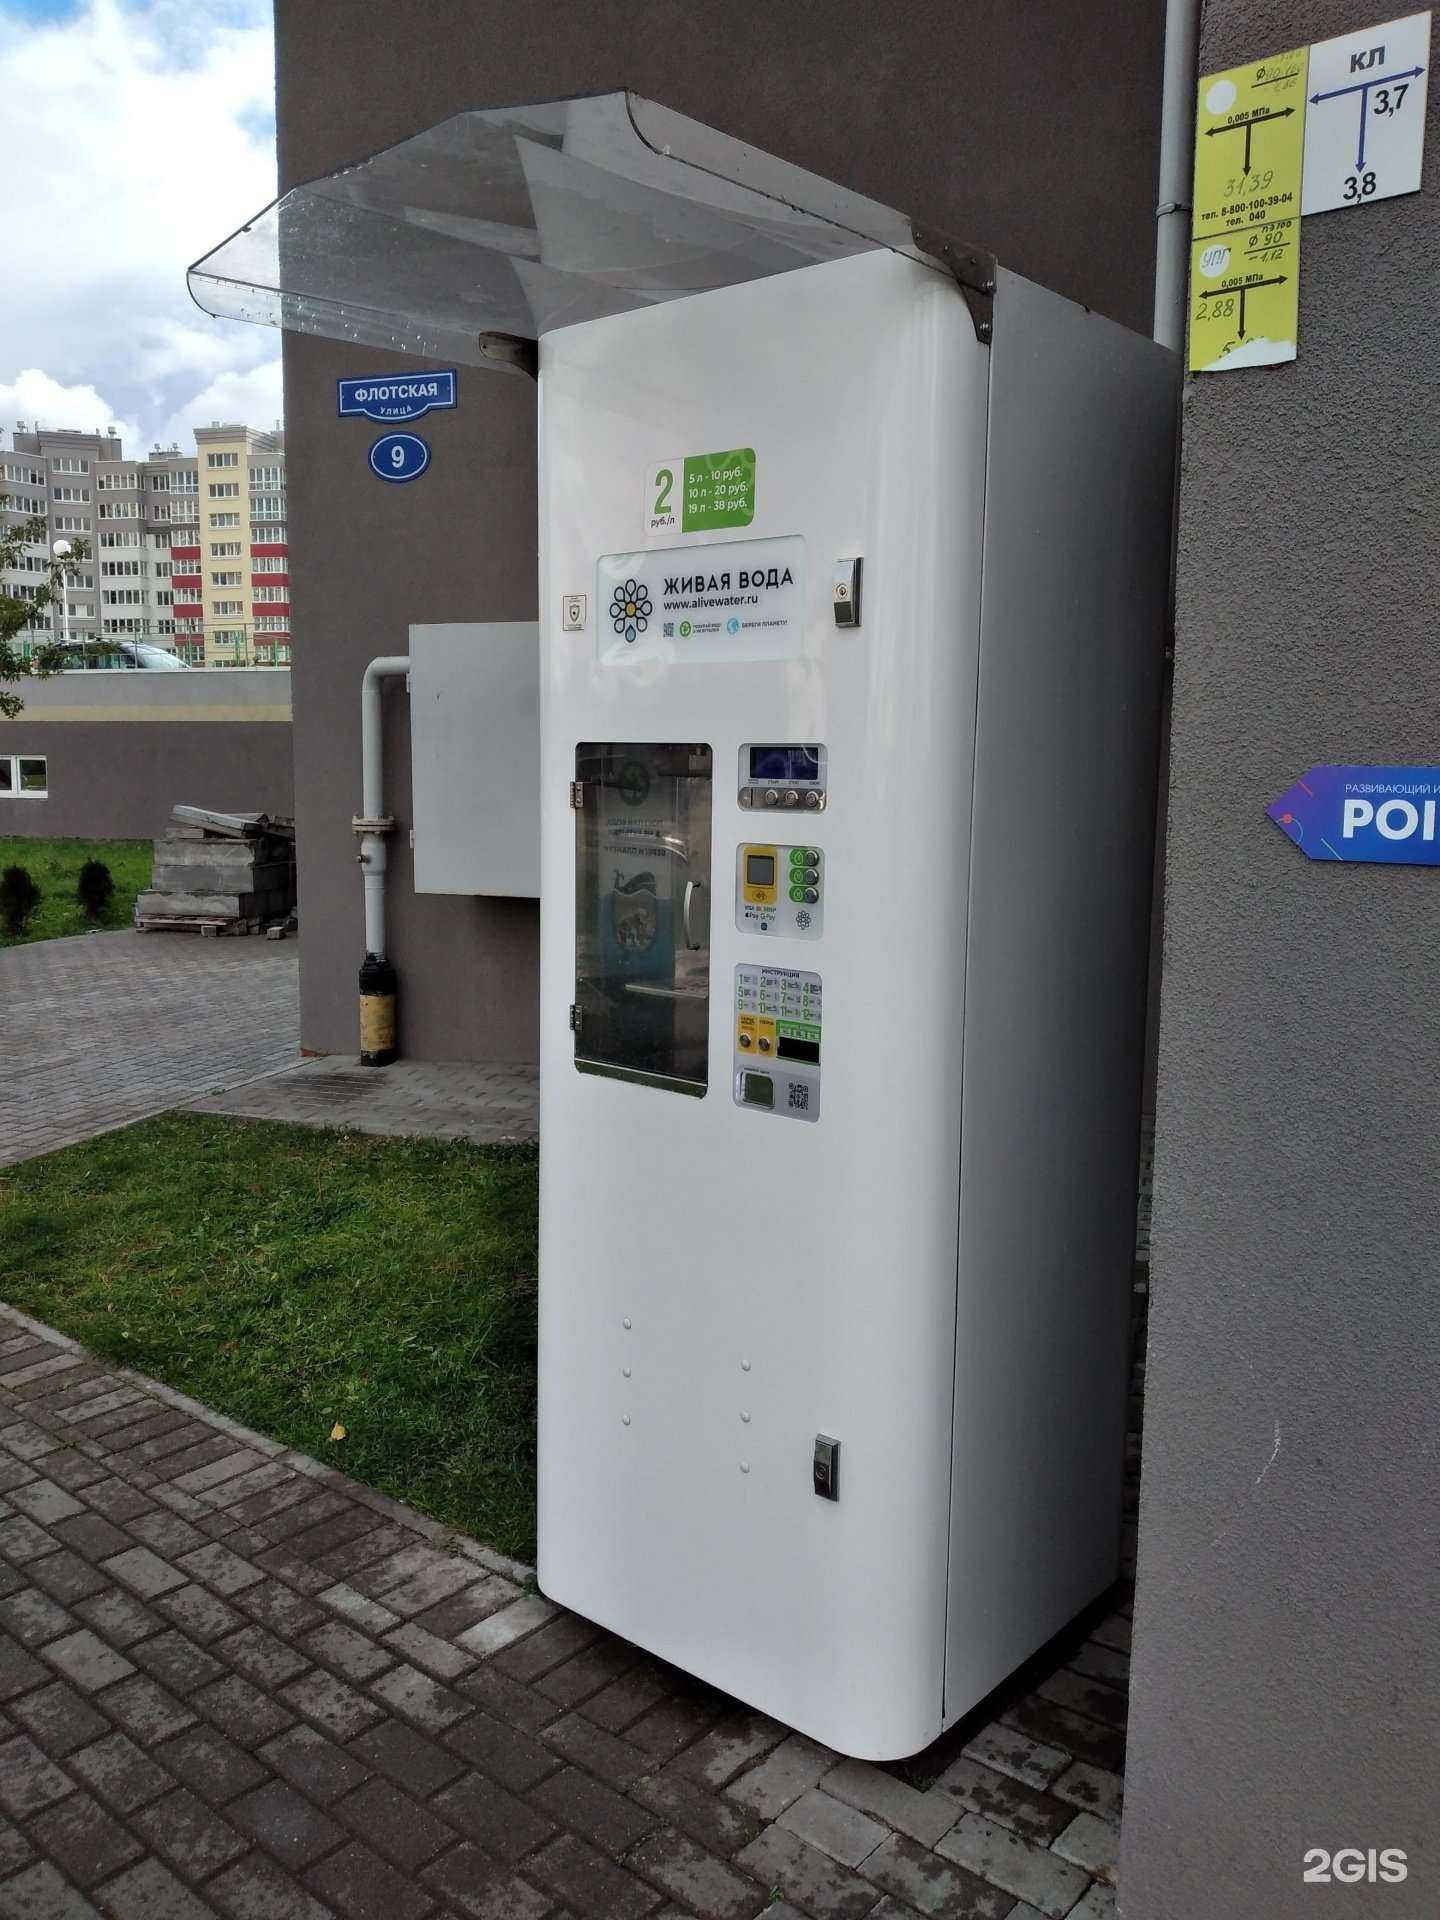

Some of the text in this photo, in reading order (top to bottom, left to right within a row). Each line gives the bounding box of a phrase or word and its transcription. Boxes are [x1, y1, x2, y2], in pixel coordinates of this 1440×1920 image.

[1350, 45, 1386, 73] КЛ
[1373, 84, 1411, 118] 3,7
[1227, 106, 1271, 125] 0,005 МПа
[1343, 172, 1377, 203] 3,8
[1201, 192, 1293, 221] тел. 8-800-100-39-04
[1226, 210, 1266, 227] тел. 040
[1264, 231, 1283, 246] 90
[1221, 273, 1264, 289] 0,005 МПа
[1195, 299, 1236, 322] 2,88
[354, 382, 438, 402] ФЛОТСКАЯ
[380, 404, 413, 416] УЛИЦА
[391, 445, 405, 468] 9
[688, 474, 695, 484] 5
[697, 475, 703, 483] л
[711, 470, 721, 481] 10
[722, 466, 743, 481] руб.
[654, 468, 674, 515] 2
[689, 488, 698, 499] 10
[700, 488, 707, 497] л
[715, 485, 726, 496] 20
[728, 481, 748, 495] руб.
[688, 503, 698, 514] 19
[699, 504, 706, 513] л
[713, 500, 725, 511] 38
[727, 497, 748, 512] руб.
[664, 568, 794, 595] ЖИВАЯ ВОДА
[664, 595, 759, 610] www.alivewater.ru
[1345, 783, 1430, 795] РАЗВИВАЮЩИЙ
[1342, 799, 1436, 840] POI
